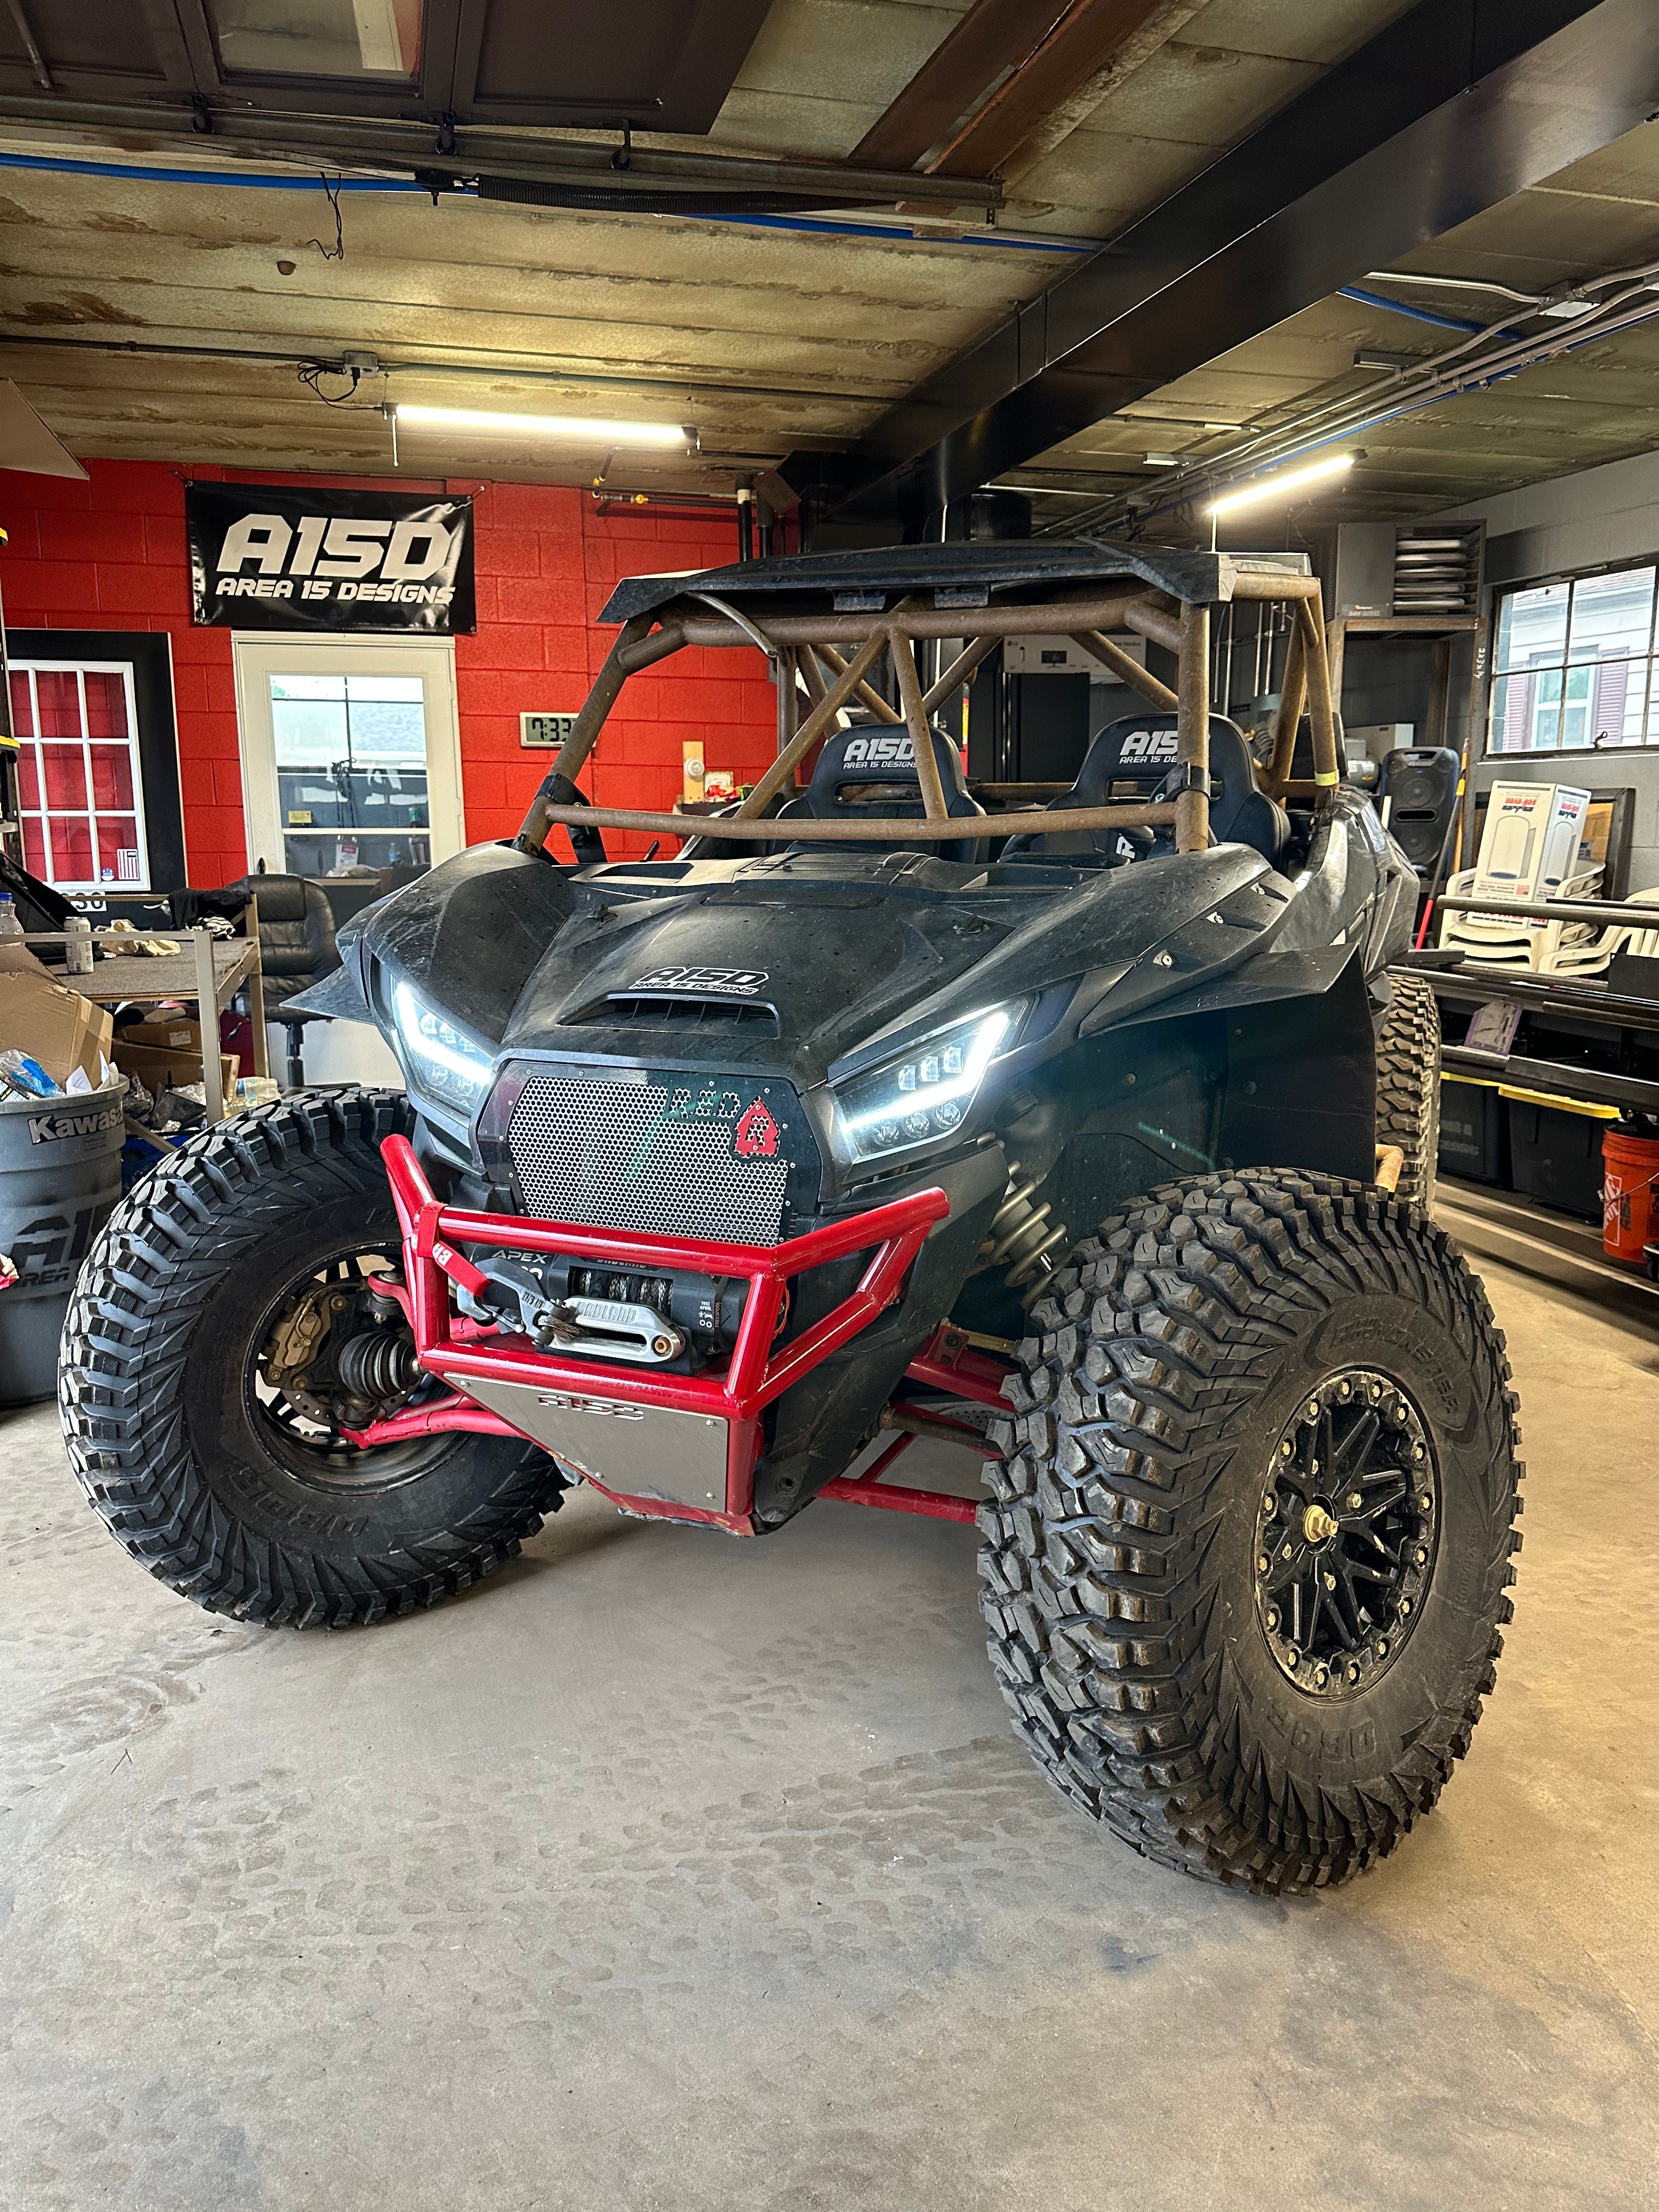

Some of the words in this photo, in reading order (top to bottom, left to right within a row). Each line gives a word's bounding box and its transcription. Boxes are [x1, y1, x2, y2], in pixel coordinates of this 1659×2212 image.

[216, 513, 452, 581] A15D
[216, 578, 294, 599] AREA
[301, 580, 333, 600] 15
[337, 582, 456, 605] DESIGNS
[532, 717, 572, 742] 7:33
[1119, 730, 1178, 755] A15
[843, 761, 867, 770] AREA
[1119, 755, 1148, 764] AREA
[691, 983, 757, 995] DESIGNS
[668, 1087, 741, 1119] RED
[492, 1249, 550, 1265] APEX
[18, 1267, 70, 1288] REA
[575, 1301, 637, 1323] BADLAND
